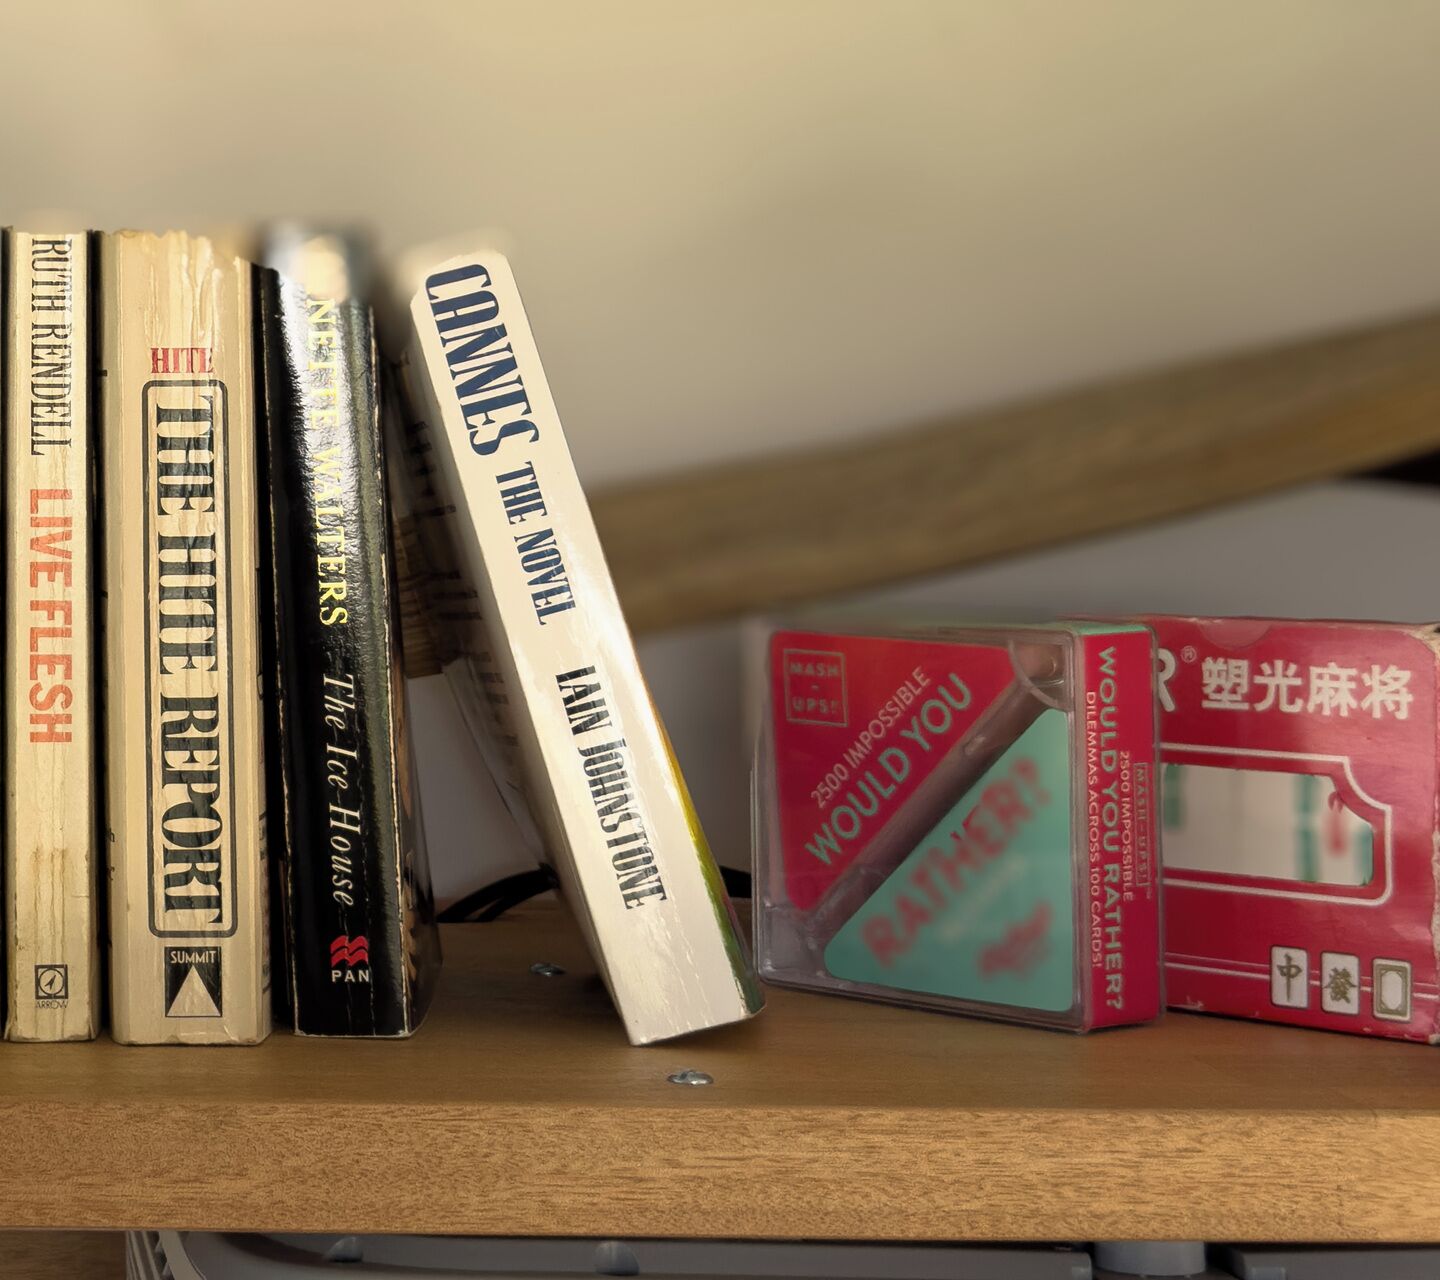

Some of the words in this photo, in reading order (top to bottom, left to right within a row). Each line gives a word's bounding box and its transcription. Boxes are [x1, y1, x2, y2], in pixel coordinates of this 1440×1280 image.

[30, 238, 73, 312] RUTH
[30, 322, 73, 456] RENDELL
[150, 347, 214, 374] HITE
[425, 263, 540, 456] CANNES
[156, 394, 216, 516] THE
[495, 461, 548, 525] THE
[29, 488, 73, 587] LIVE
[311, 447, 349, 627] WALTERS
[513, 527, 577, 626] NOVEL
[157, 532, 219, 675] HITE
[28, 599, 74, 743] FLESH
[323, 673, 357, 730] The
[555, 665, 613, 737] IAIN
[789, 662, 840, 678] MASH
[1098, 646, 1118, 773] WOULD
[1201, 655, 1414, 720] 塑光麻将
[326, 742, 358, 790] Ice
[804, 746, 912, 865] WOULD
[900, 672, 973, 752] YOU
[810, 762, 849, 809] 2500
[845, 666, 931, 769] IMPOSSIBLE
[1086, 691, 1099, 785] DILEMMAS
[1119, 750, 1131, 793] 2500
[160, 692, 223, 924] REPORT
[577, 737, 668, 910] JOHNSTONE
[1088, 789, 1101, 863] ACROSS
[1101, 780, 1121, 852] YOU
[1121, 797, 1134, 902] IMPOSSIBLE
[329, 801, 362, 907] House
[1090, 867, 1102, 896] 100
[170, 950, 217, 966] SUMMIT
[331, 970, 370, 983] PAN
[1091, 901, 1103, 968] CARDS!
[1103, 863, 1124, 1010] RATHER?
[36, 1001, 69, 1009] ARROW
[1276, 952, 1303, 1003] 中
